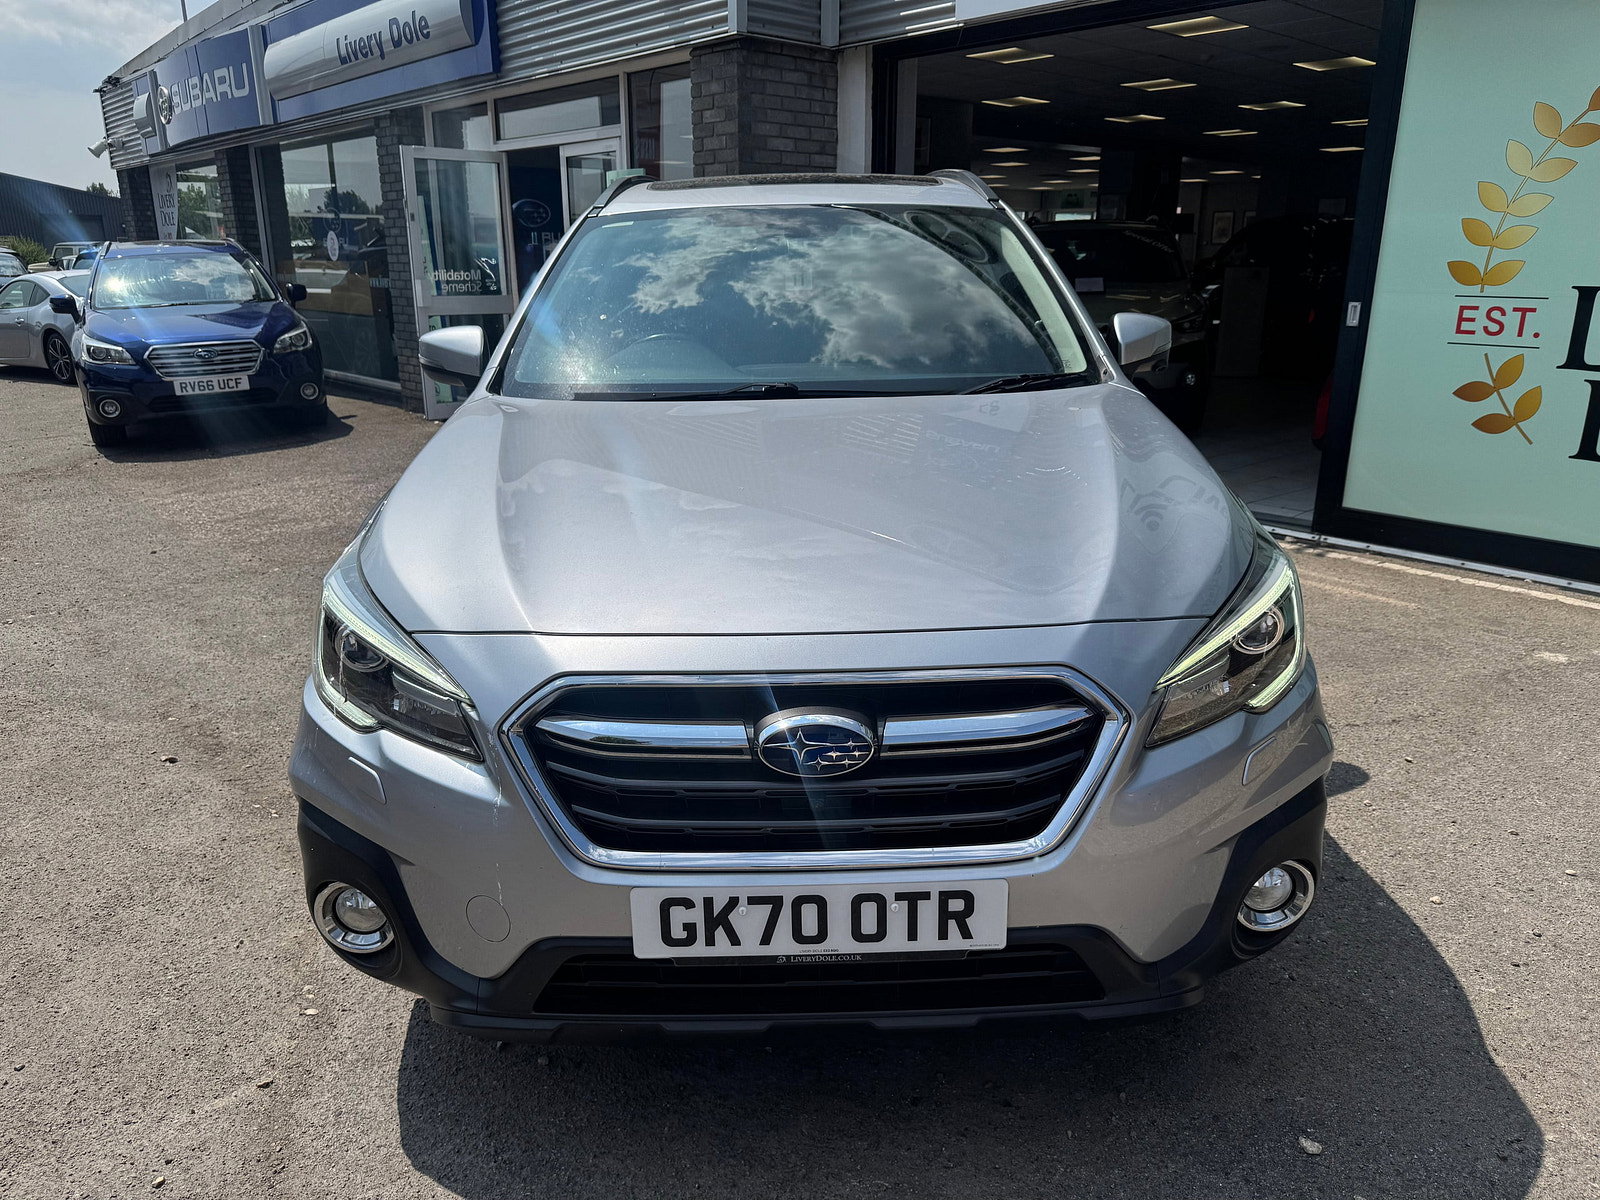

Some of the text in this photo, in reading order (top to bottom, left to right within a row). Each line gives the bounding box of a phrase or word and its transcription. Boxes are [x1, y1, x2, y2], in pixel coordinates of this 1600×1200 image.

[336, 10, 431, 65] Livery Dole
[171, 62, 250, 115] SUBARU
[1454, 305, 1541, 339] EST.
[179, 377, 242, 393] RV66 UCF
[659, 889, 975, 947] GK70 OTR
